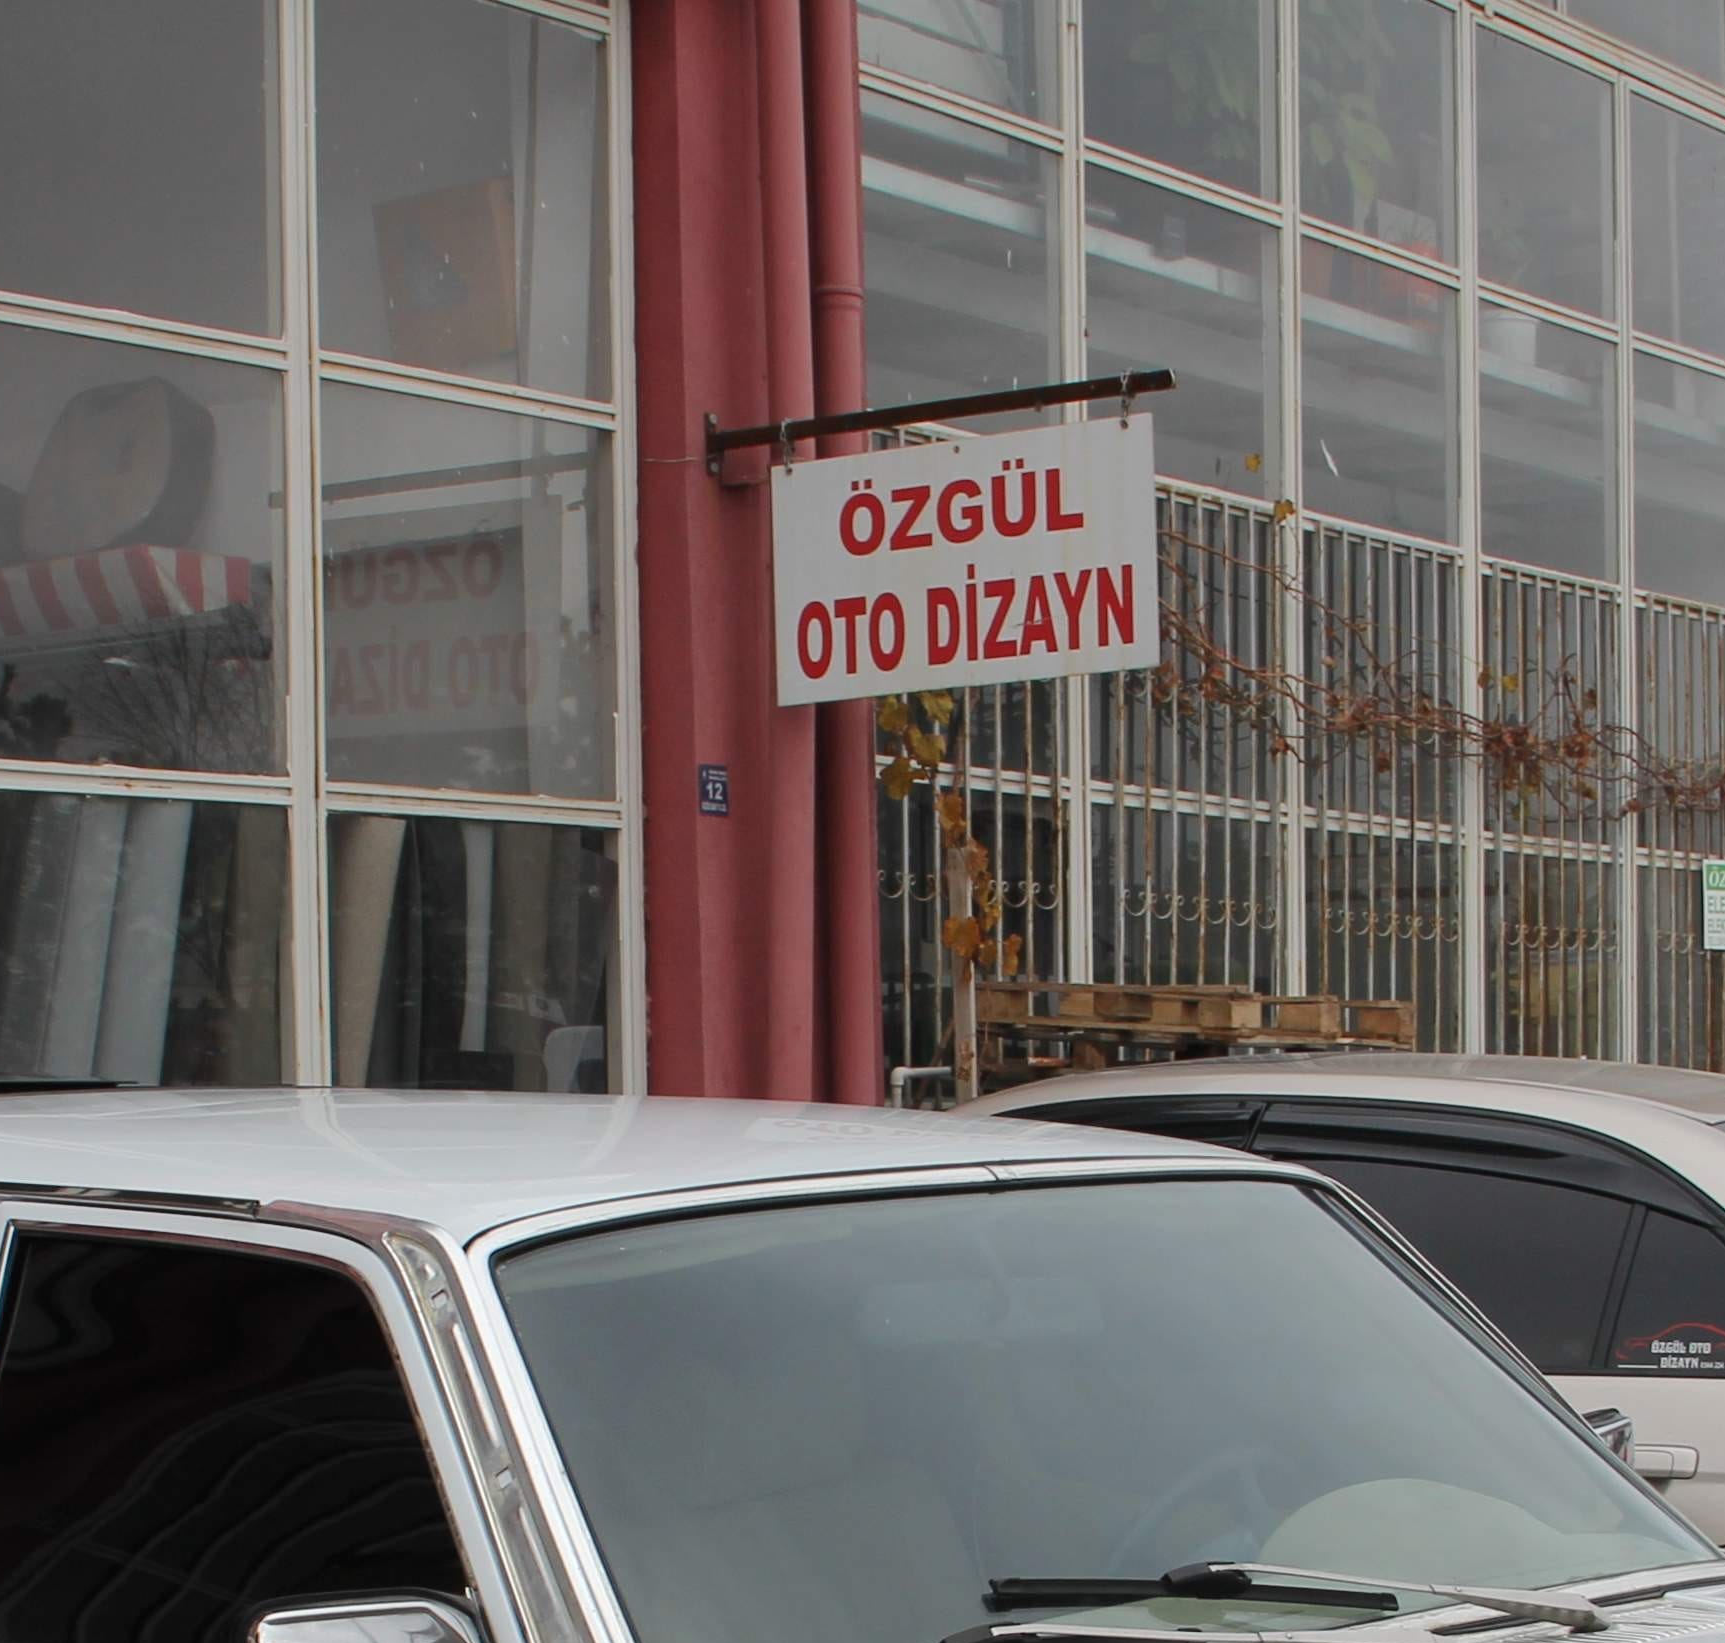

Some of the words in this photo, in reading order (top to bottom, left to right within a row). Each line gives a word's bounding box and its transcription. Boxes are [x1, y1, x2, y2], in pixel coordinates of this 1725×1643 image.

[839, 457, 1085, 557] ÖZGÜL
[796, 592, 906, 680] OTO
[926, 563, 1135, 667] DİZAYN
[706, 781, 723, 800] 12
[1651, 1339, 1686, 1354] ÖZGÜL
[1689, 1342, 1712, 1354] OTO
[1660, 1355, 1700, 1369] DİZAYN
